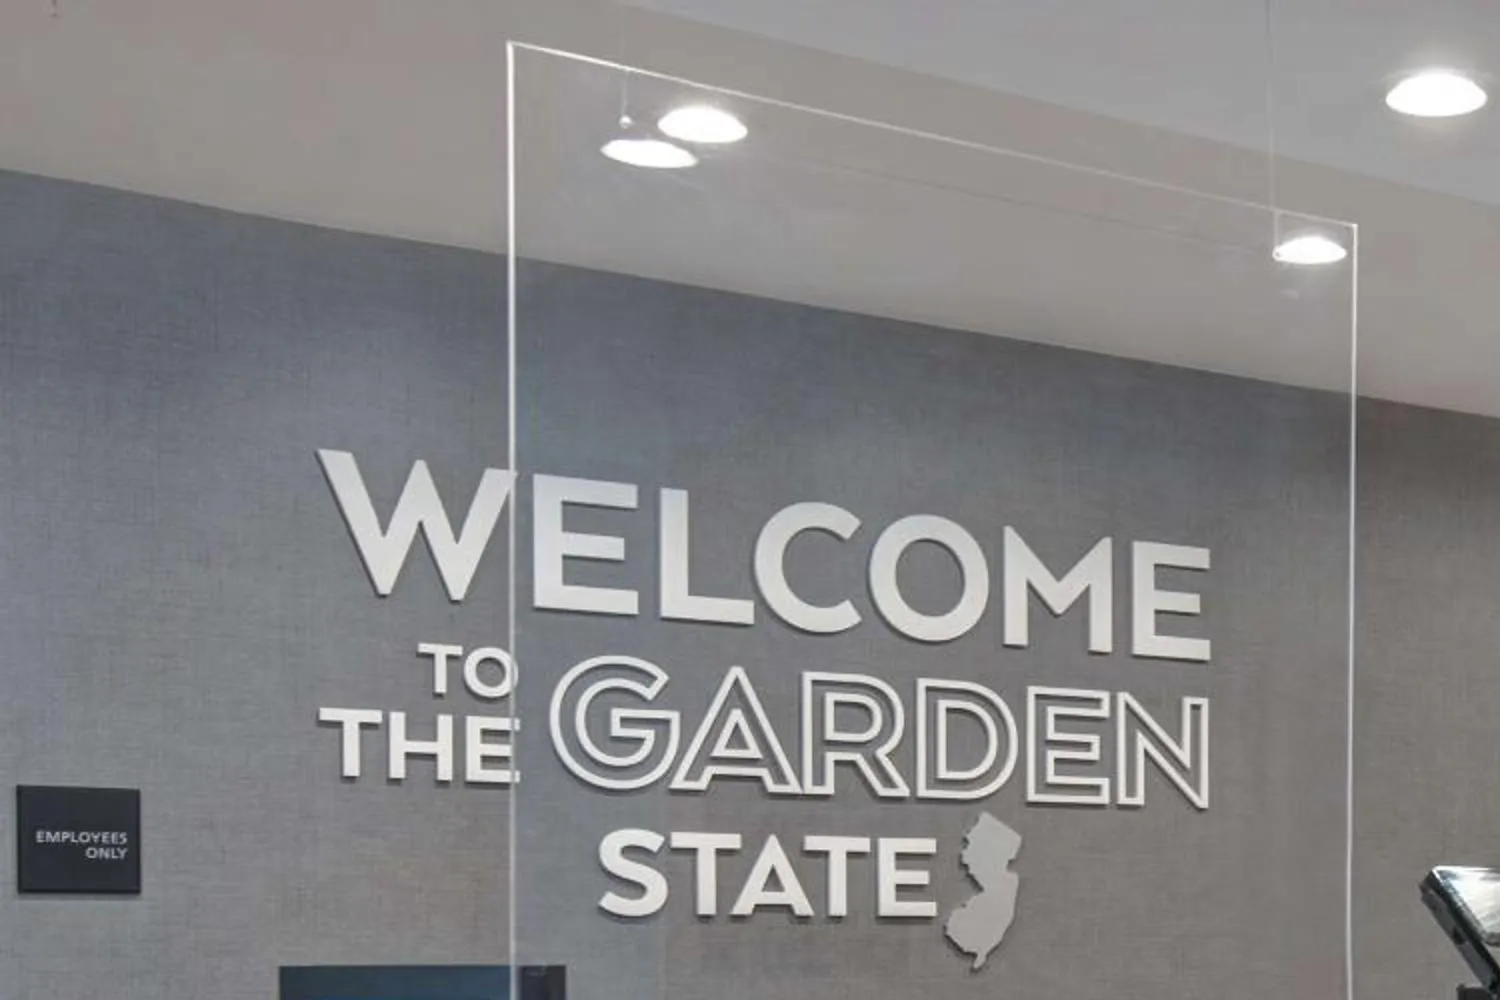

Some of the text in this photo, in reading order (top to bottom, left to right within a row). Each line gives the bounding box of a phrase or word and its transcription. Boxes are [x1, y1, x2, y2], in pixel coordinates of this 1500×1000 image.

[316, 449, 1211, 661] WELCOME
[418, 643, 519, 698] TO
[319, 654, 1209, 809] THE GARDEN
[36, 830, 127, 844] EMPLOYEES
[85, 847, 127, 859] ONLY
[598, 828, 938, 917] STATE
